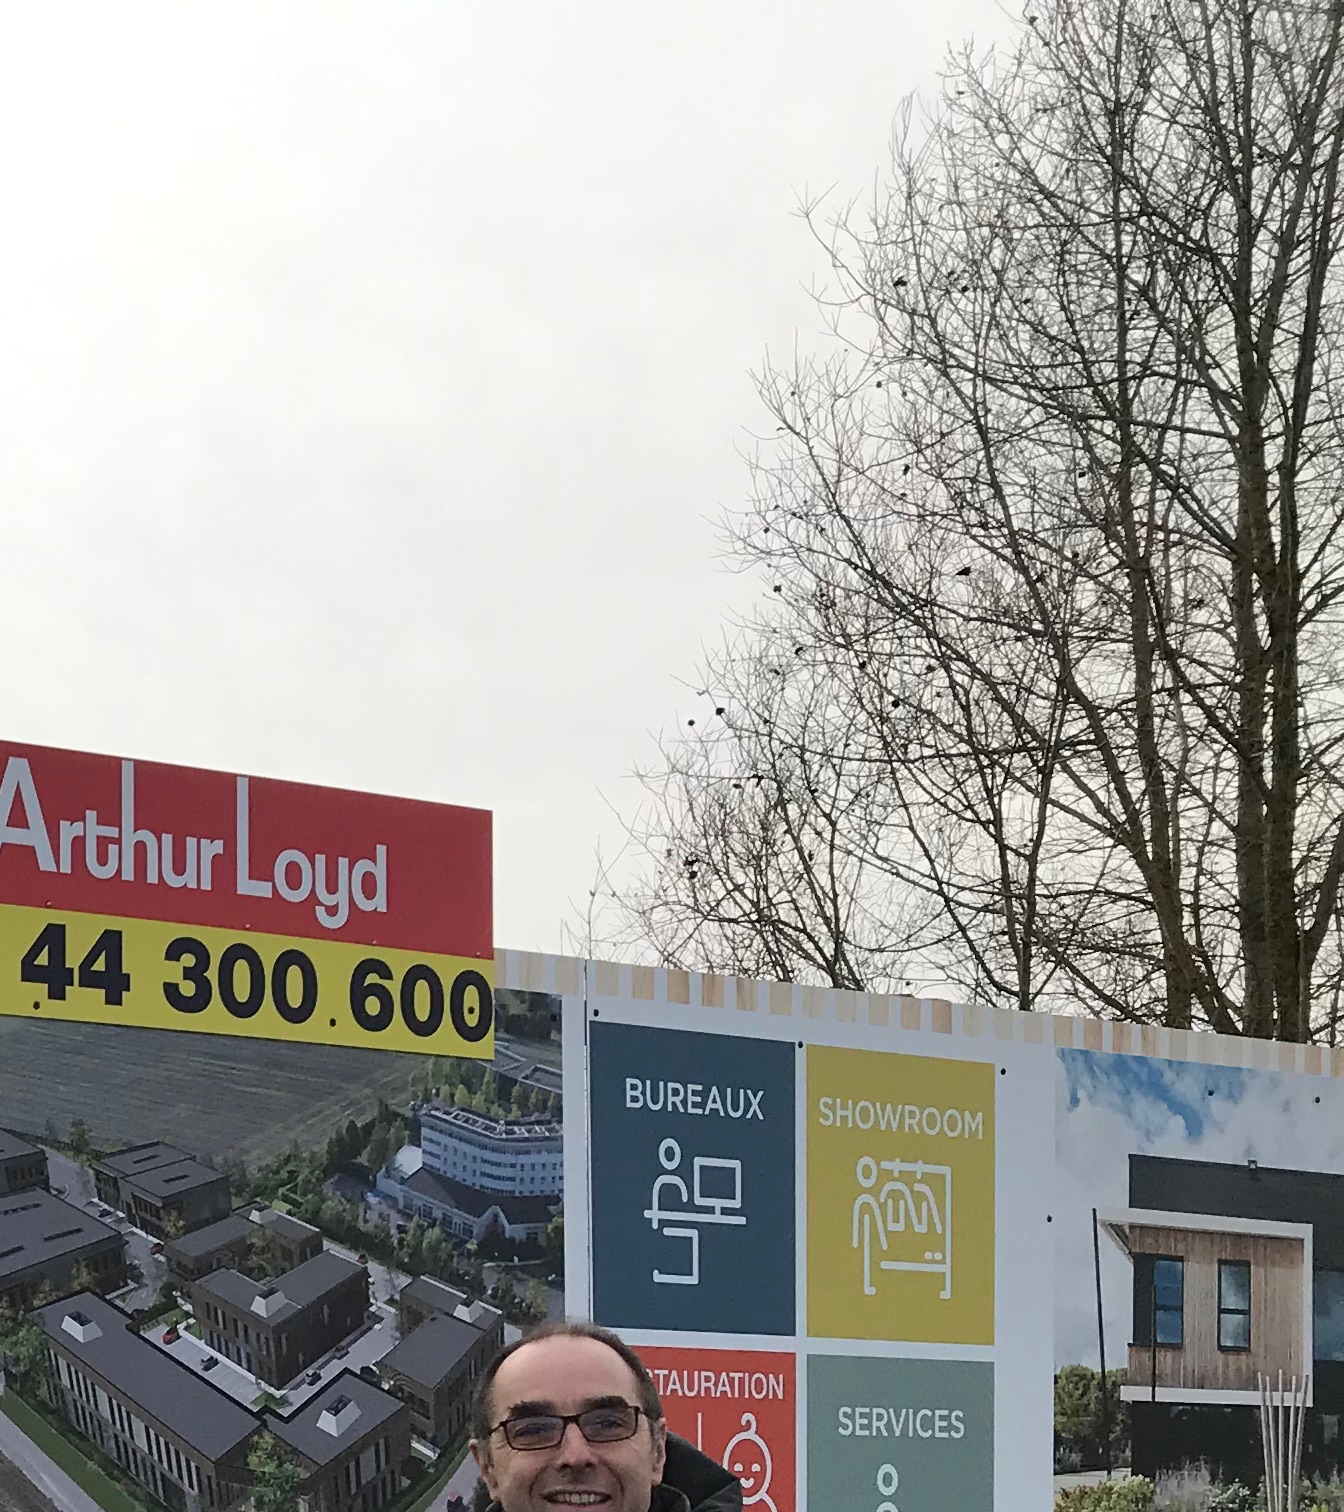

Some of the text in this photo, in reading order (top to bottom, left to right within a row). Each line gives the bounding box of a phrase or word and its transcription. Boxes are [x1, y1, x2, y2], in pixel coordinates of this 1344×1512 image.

[235, 776, 388, 930] Loyd
[20, 922, 132, 1007] 44
[162, 936, 319, 1025] 300
[349, 957, 494, 1043] 600
[624, 1077, 765, 1122] BUREAUX
[817, 1097, 984, 1141] SHOWROOM
[646, 1368, 784, 1400] TAURATION
[837, 1407, 966, 1440] SERVICES
